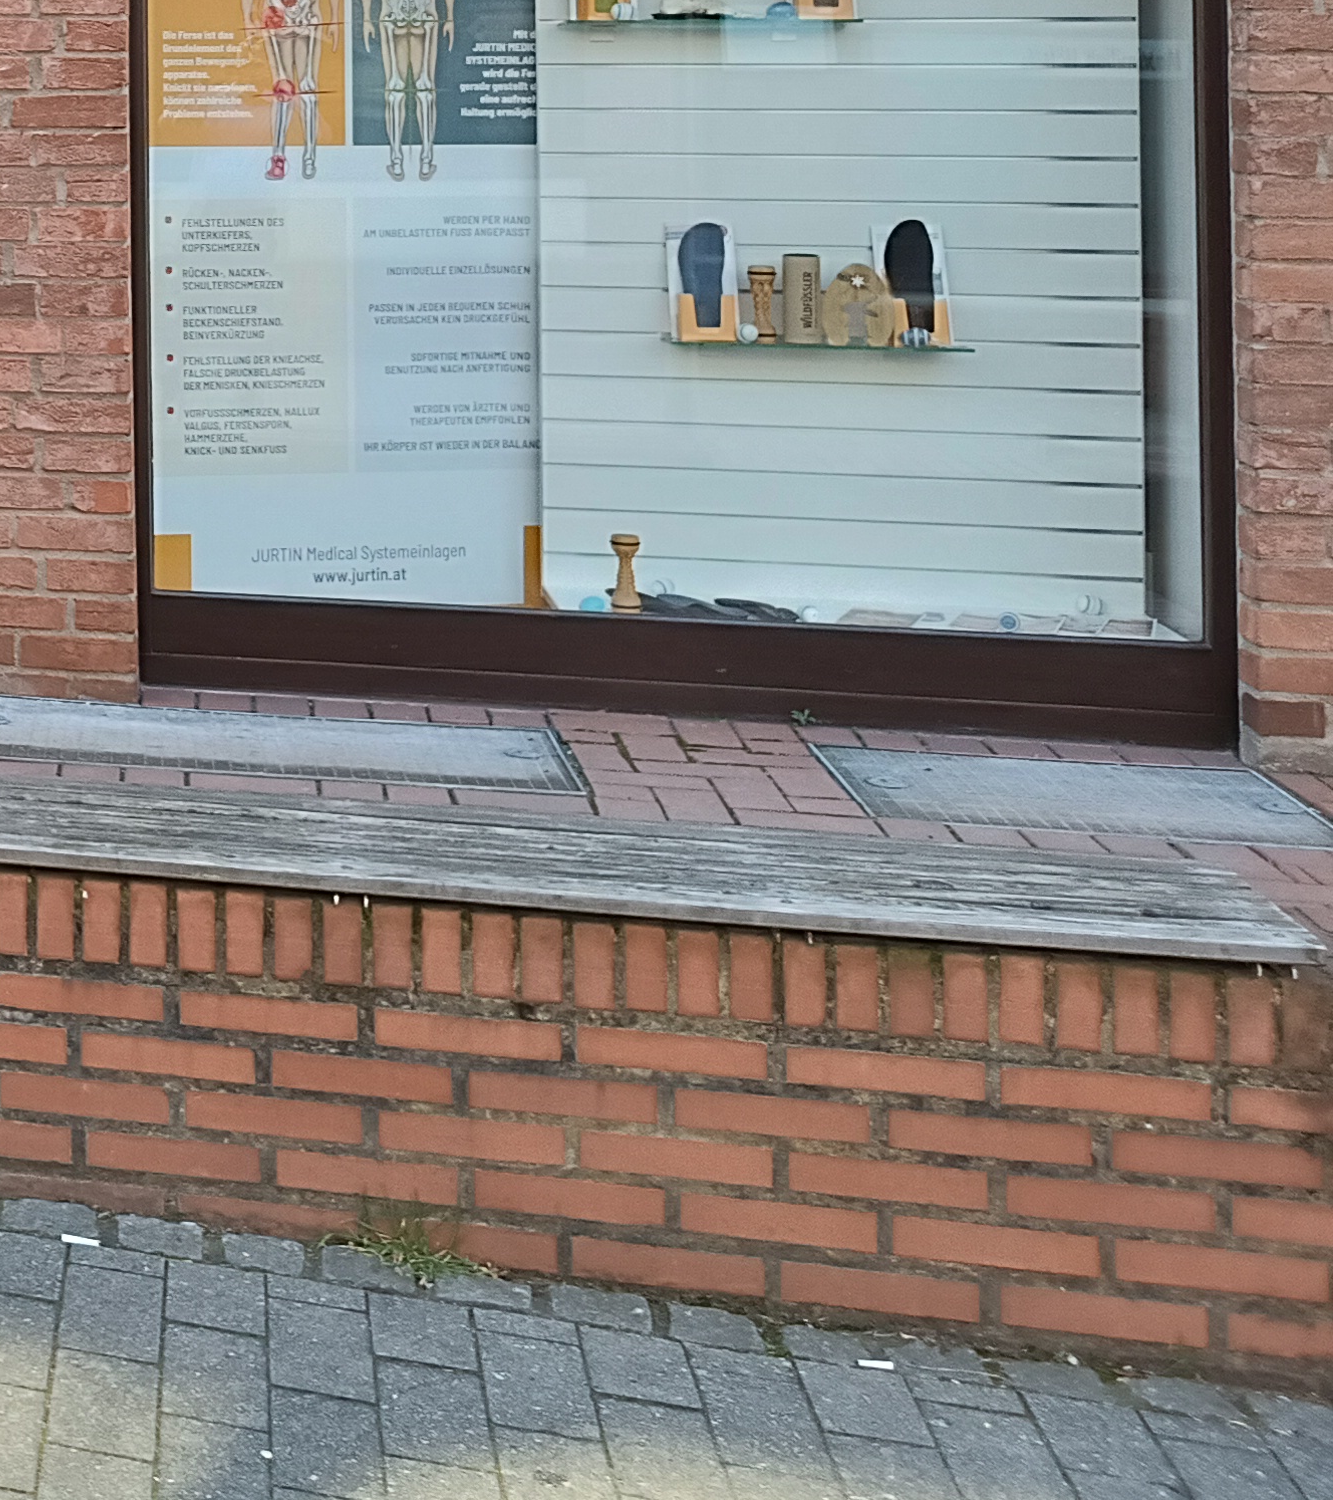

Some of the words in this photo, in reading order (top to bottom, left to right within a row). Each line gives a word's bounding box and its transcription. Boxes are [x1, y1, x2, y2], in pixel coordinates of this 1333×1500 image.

[443, 215, 479, 225] WERDEN
[483, 215, 499, 225] PER
[503, 215, 530, 225] HAND
[363, 229, 376, 238] AM
[379, 229, 448, 238] UNBELASTETEN
[450, 229, 472, 238] FUSS
[474, 228, 530, 237] ANGEPASST
[182, 243, 260, 253] KOPFSCHMERZEN
[387, 265, 447, 276] INDIVIDUELLE
[449, 263, 530, 275] EINZELLÖSUNGEN
[182, 280, 283, 290] SCHULTERSCHMERZEN
[182, 305, 257, 315] FUNKTIONELLER
[411, 352, 458, 362] SOFORTIGE
[461, 351, 506, 361] MITNAHME
[510, 351, 531, 360] UND
[385, 365, 438, 375] BENUTZUNG
[441, 364, 463, 373] NACH
[466, 364, 531, 373] ANFERTIGUNG
[410, 416, 472, 426] THERAPEUTEN
[475, 415, 530, 425] EMPFOHLEN
[184, 446, 216, 455] KNICK-
[218, 446, 237, 455] UND
[239, 445, 287, 454] SENKFUSS
[363, 442, 378, 451] IHR
[381, 440, 417, 451] KÖRPER
[420, 441, 433, 450] IST
[436, 441, 469, 450] WIEDER
[472, 440, 480, 449] IN
[483, 440, 500, 449] DER
[252, 548, 302, 563] JURTIN
[307, 546, 357, 560] Medical
[362, 545, 466, 562] Systemeinlagen
[313, 567, 407, 585] www.jurtin.at
